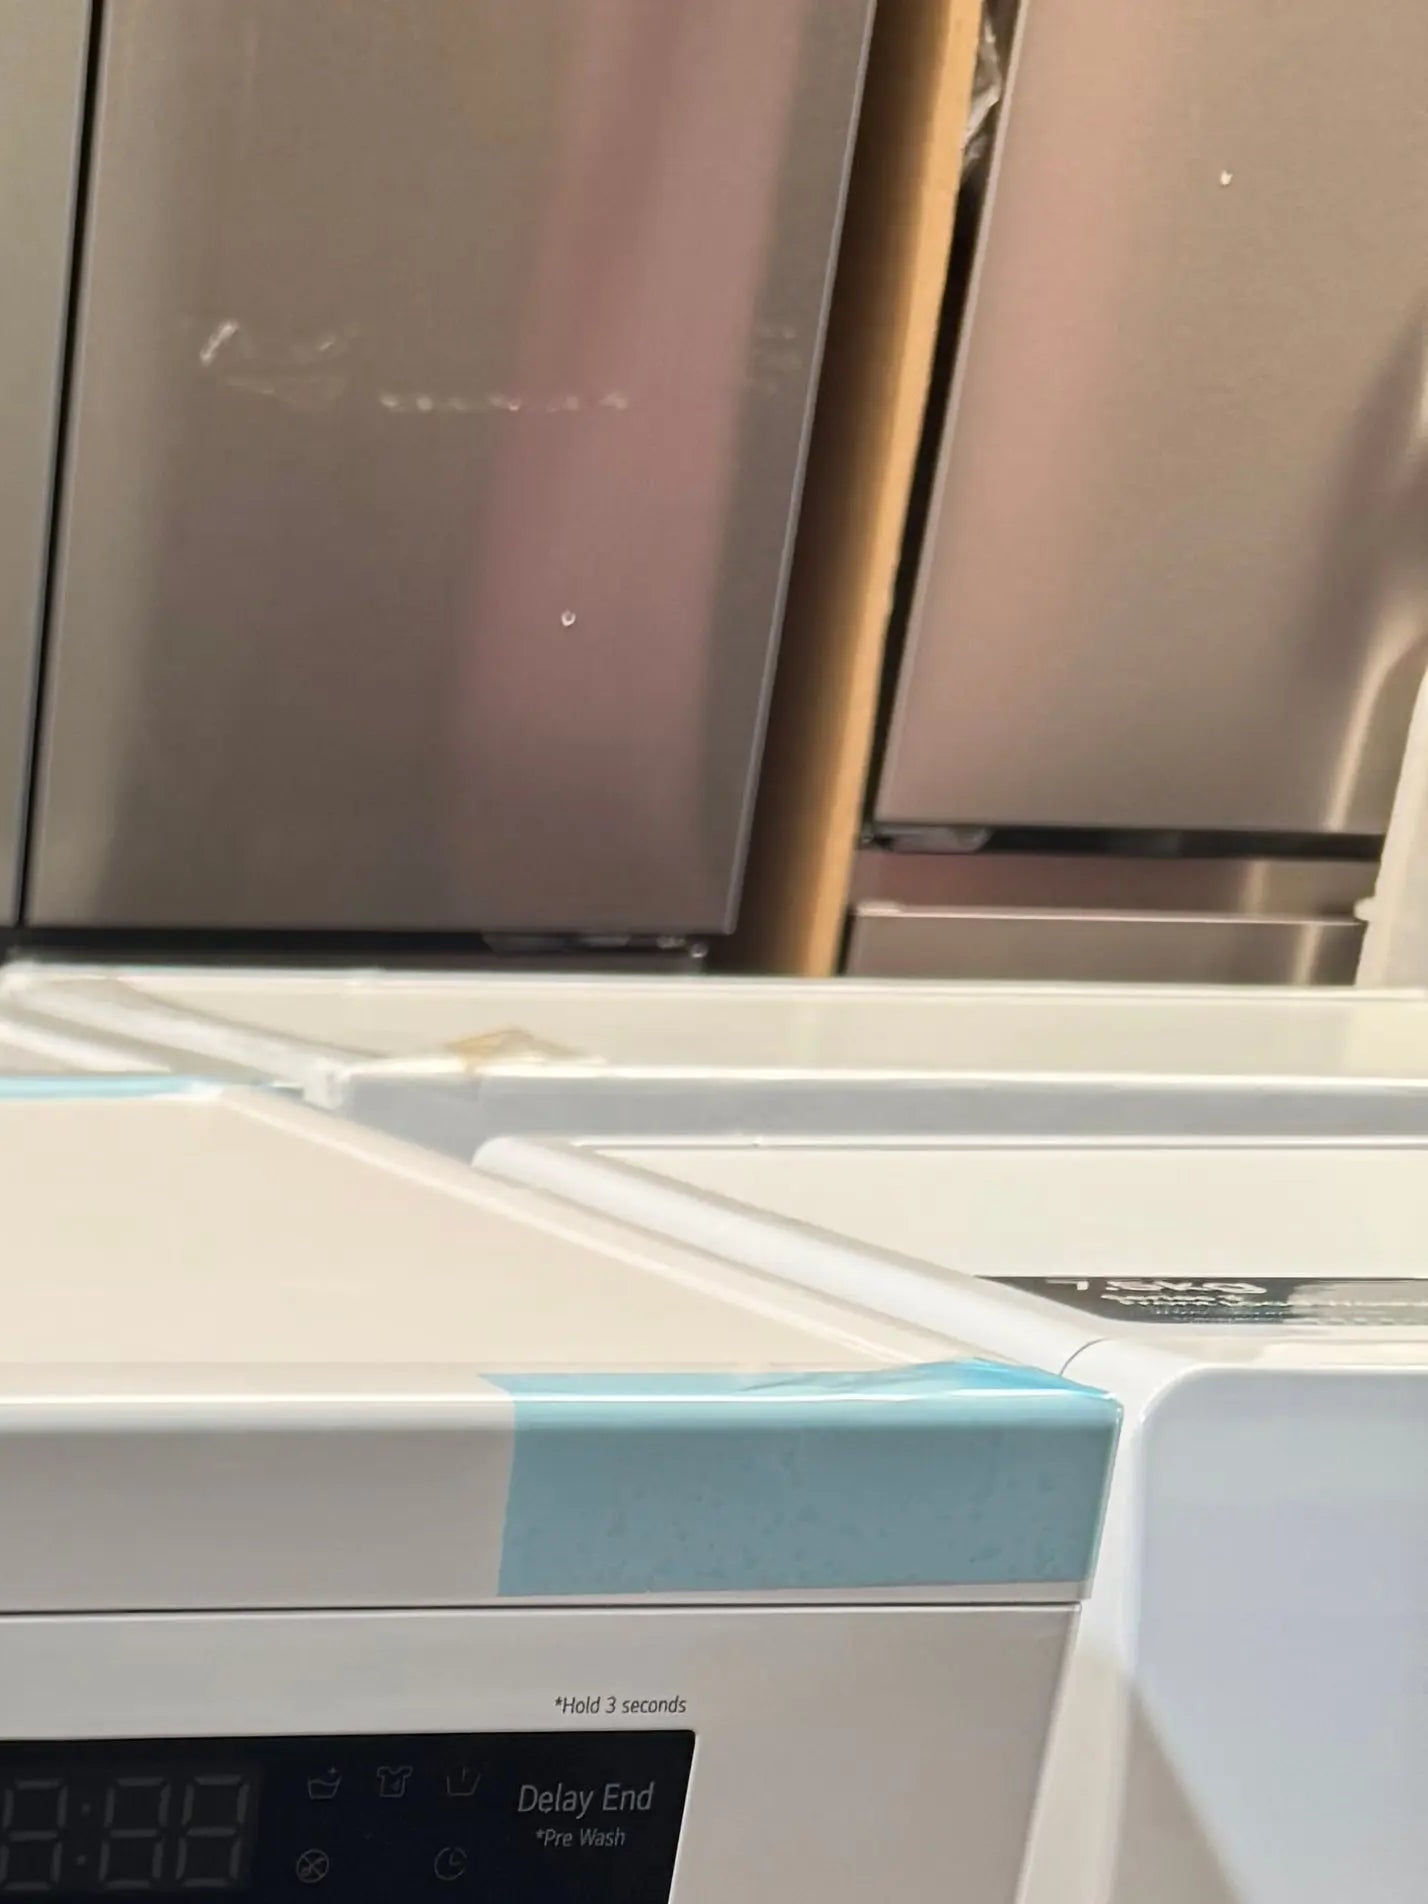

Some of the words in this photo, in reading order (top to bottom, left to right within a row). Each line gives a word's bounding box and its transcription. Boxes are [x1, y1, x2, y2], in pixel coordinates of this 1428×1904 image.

[605, 1697, 617, 1714] 3
[622, 1695, 687, 1714] seconds
[517, 1782, 594, 1820] Delay
[602, 1781, 655, 1811] End
[580, 1827, 626, 1848] Wash
